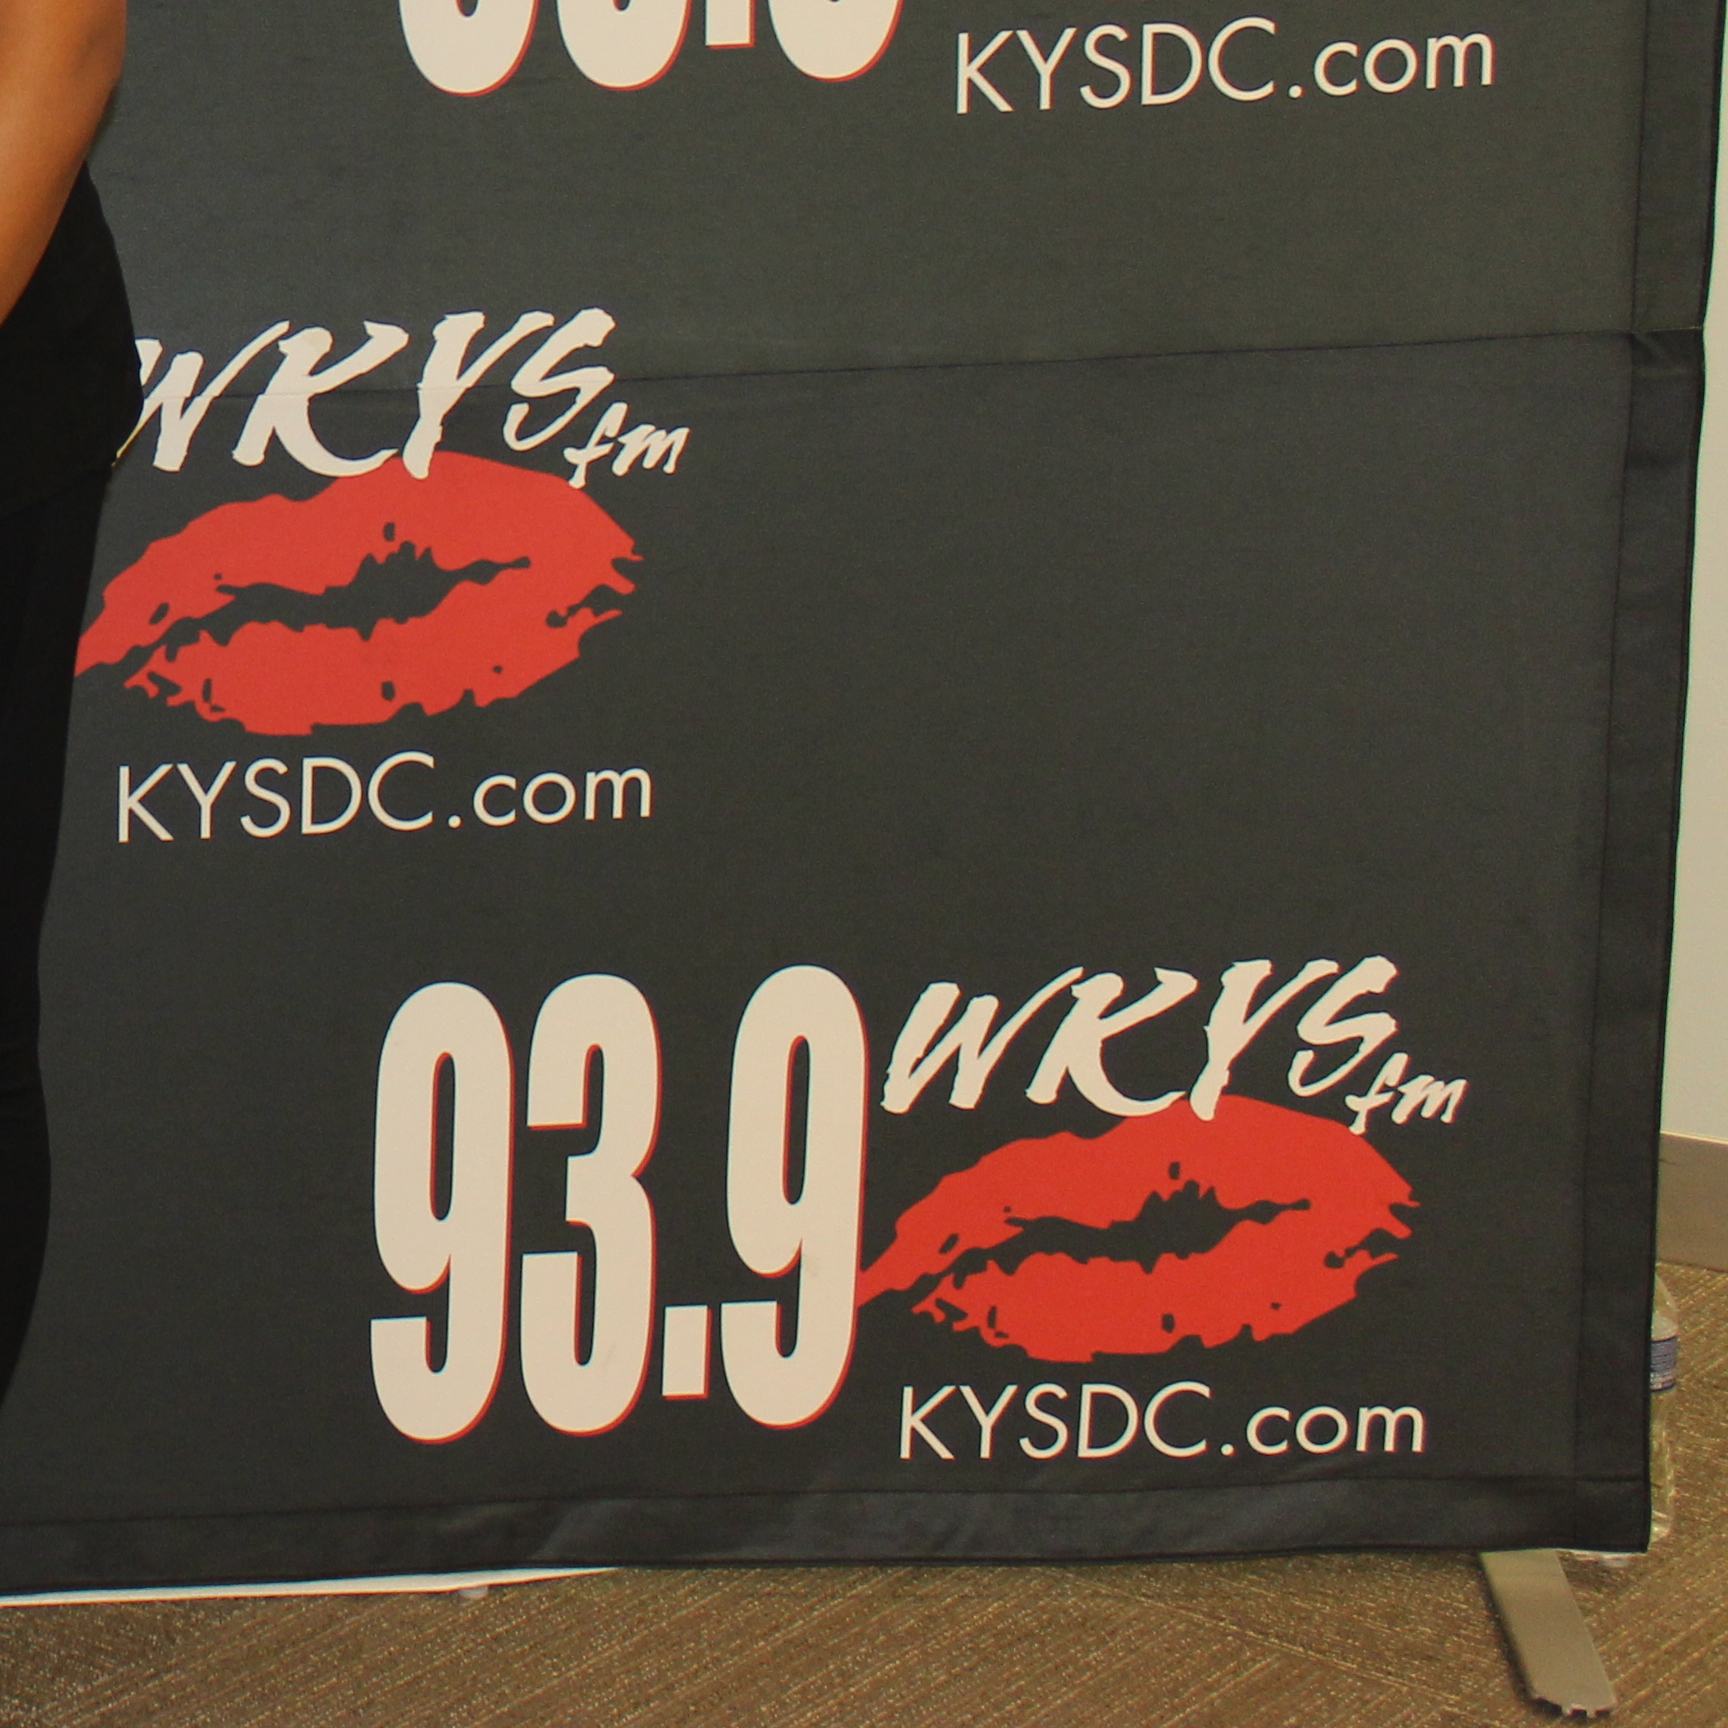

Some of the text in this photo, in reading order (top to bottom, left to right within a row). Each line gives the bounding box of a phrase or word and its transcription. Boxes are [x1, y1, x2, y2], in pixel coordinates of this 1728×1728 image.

[956, 16, 1492, 114] KYSDC.com
[111, 308, 690, 489] WKYS fm
[118, 751, 651, 842] KYSDC.com
[370, 955, 1467, 1439] 93.9 WKYS fm
[900, 1381, 1423, 1459] KYSDC.com
